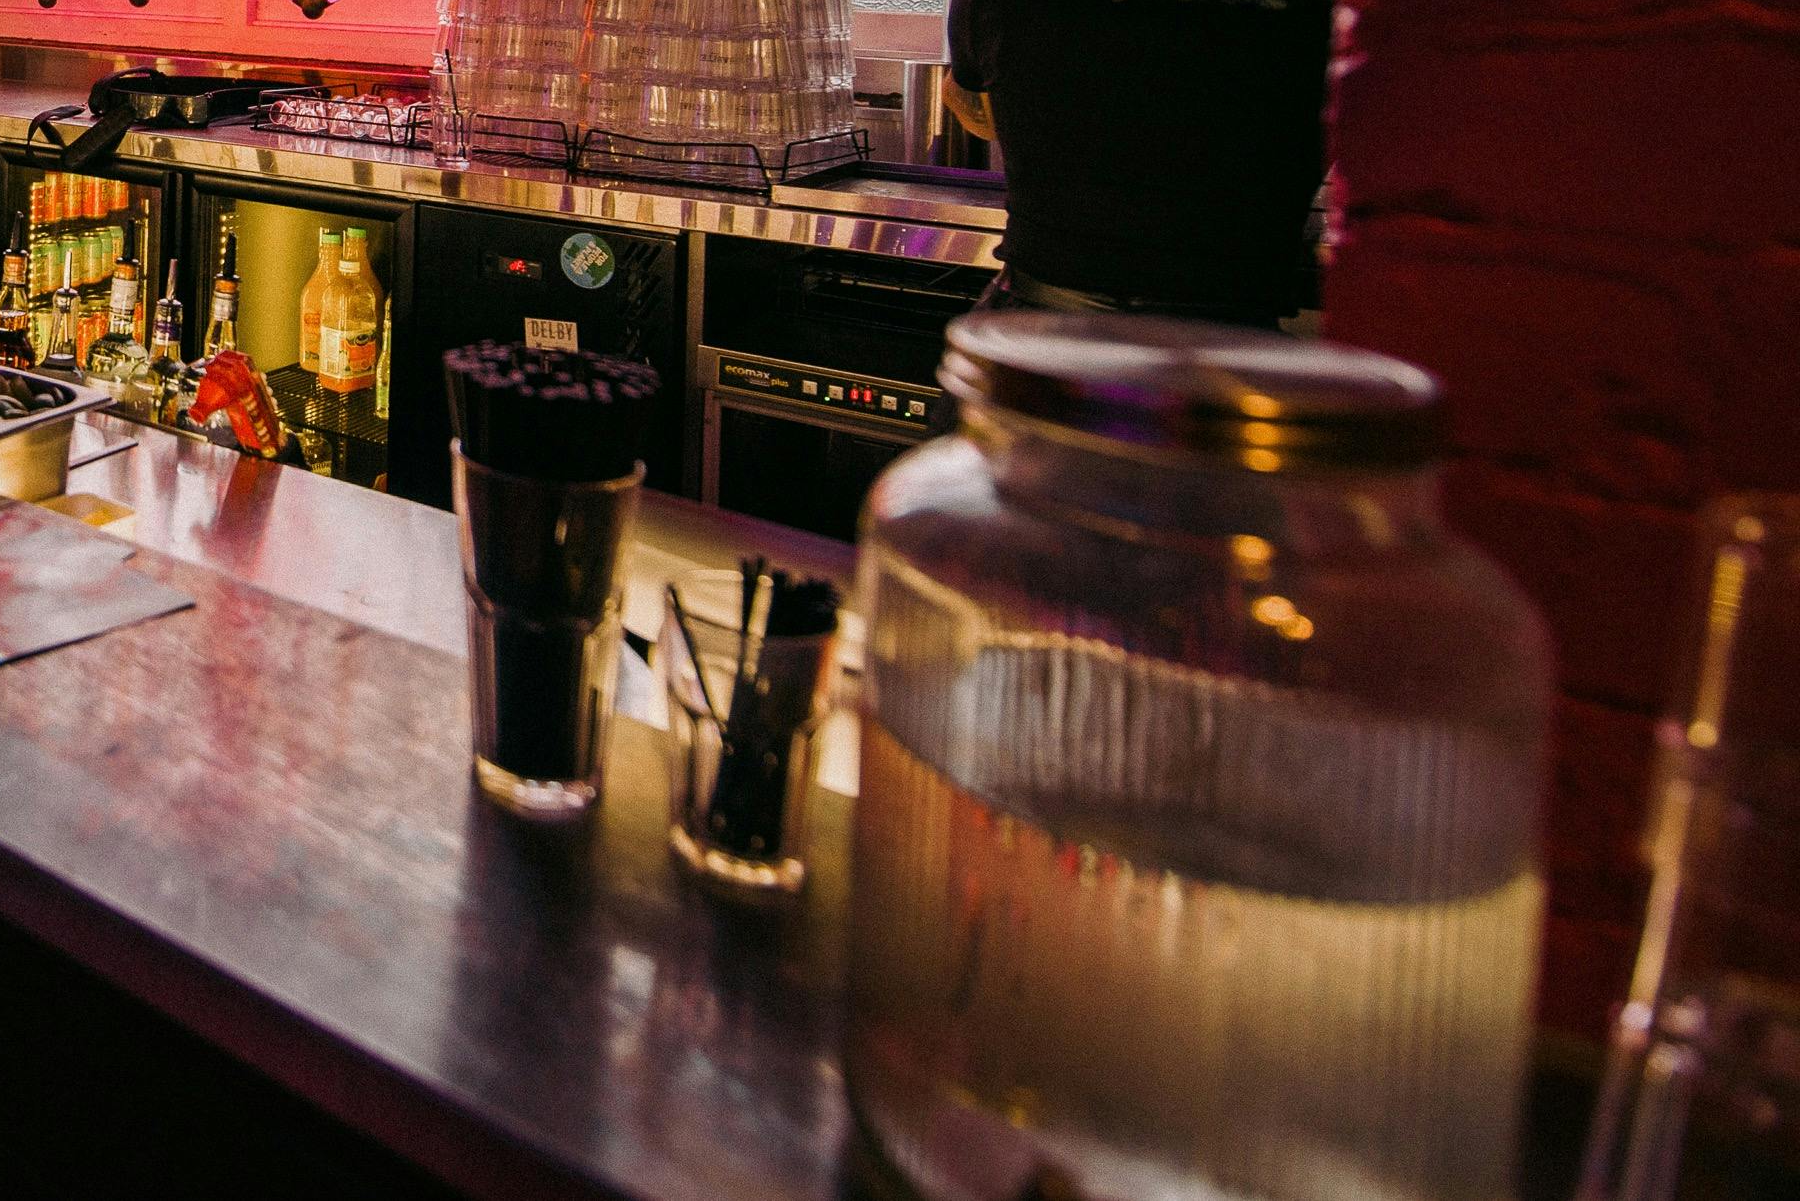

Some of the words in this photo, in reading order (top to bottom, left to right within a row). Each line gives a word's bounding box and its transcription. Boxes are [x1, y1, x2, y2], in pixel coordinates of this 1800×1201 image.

[580, 245, 603, 271] PEOPLE
[594, 251, 609, 267] FOR
[531, 320, 573, 341] DELBY
[724, 363, 771, 380] ecomax
[771, 378, 790, 389] plus
